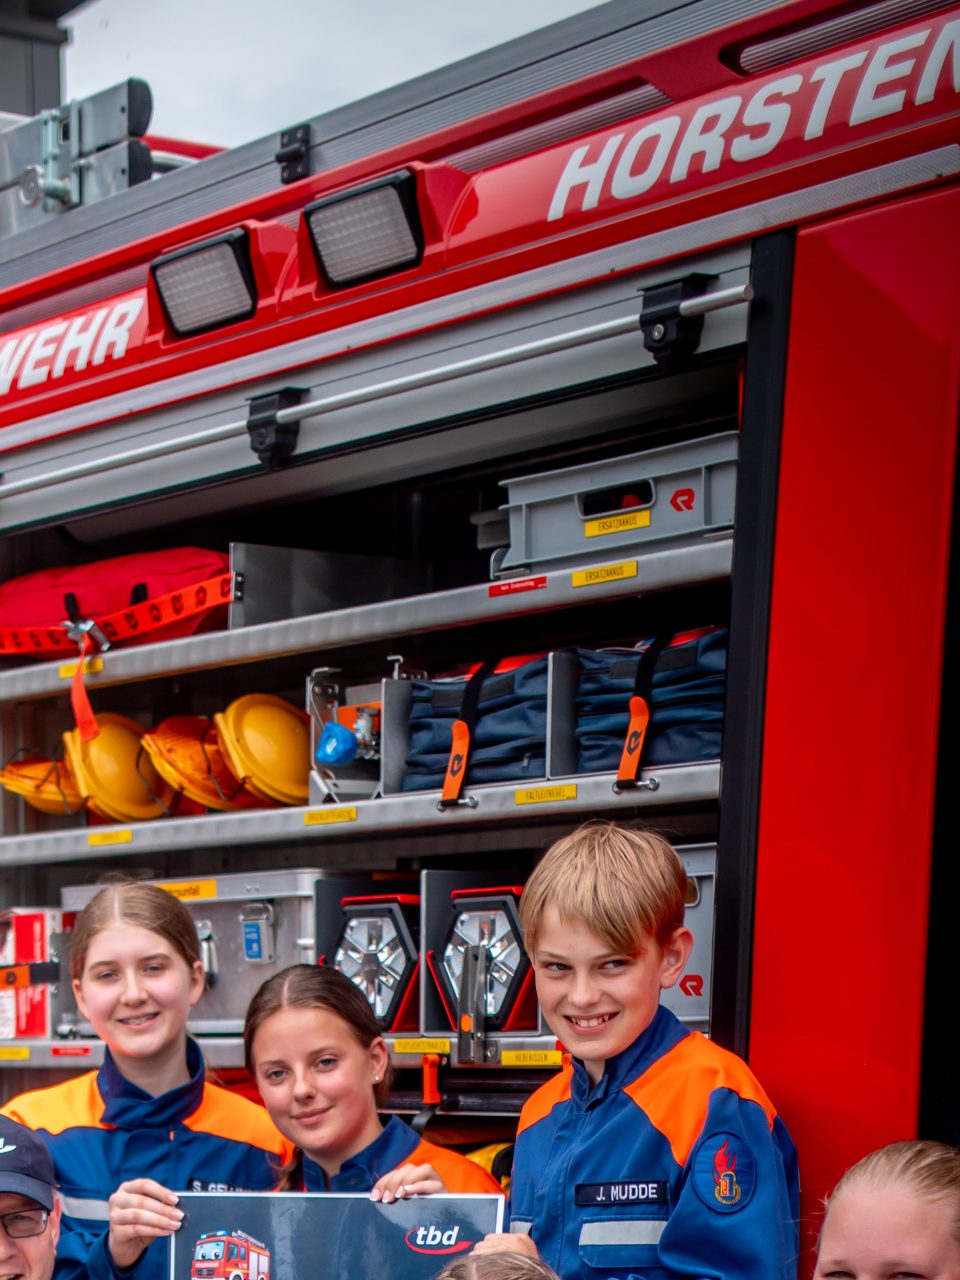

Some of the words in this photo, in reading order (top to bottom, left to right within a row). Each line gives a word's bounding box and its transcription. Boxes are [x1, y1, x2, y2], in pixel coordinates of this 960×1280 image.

[598, 516, 638, 532] ERSATZAKKUS
[585, 566, 625, 582] ERSATZAKKUS
[515, 1052, 548, 1062] HEBEKISSEN
[596, 1186, 606, 1201] J.
[610, 1183, 658, 1201] MUDDE
[415, 1225, 459, 1246] tbd
